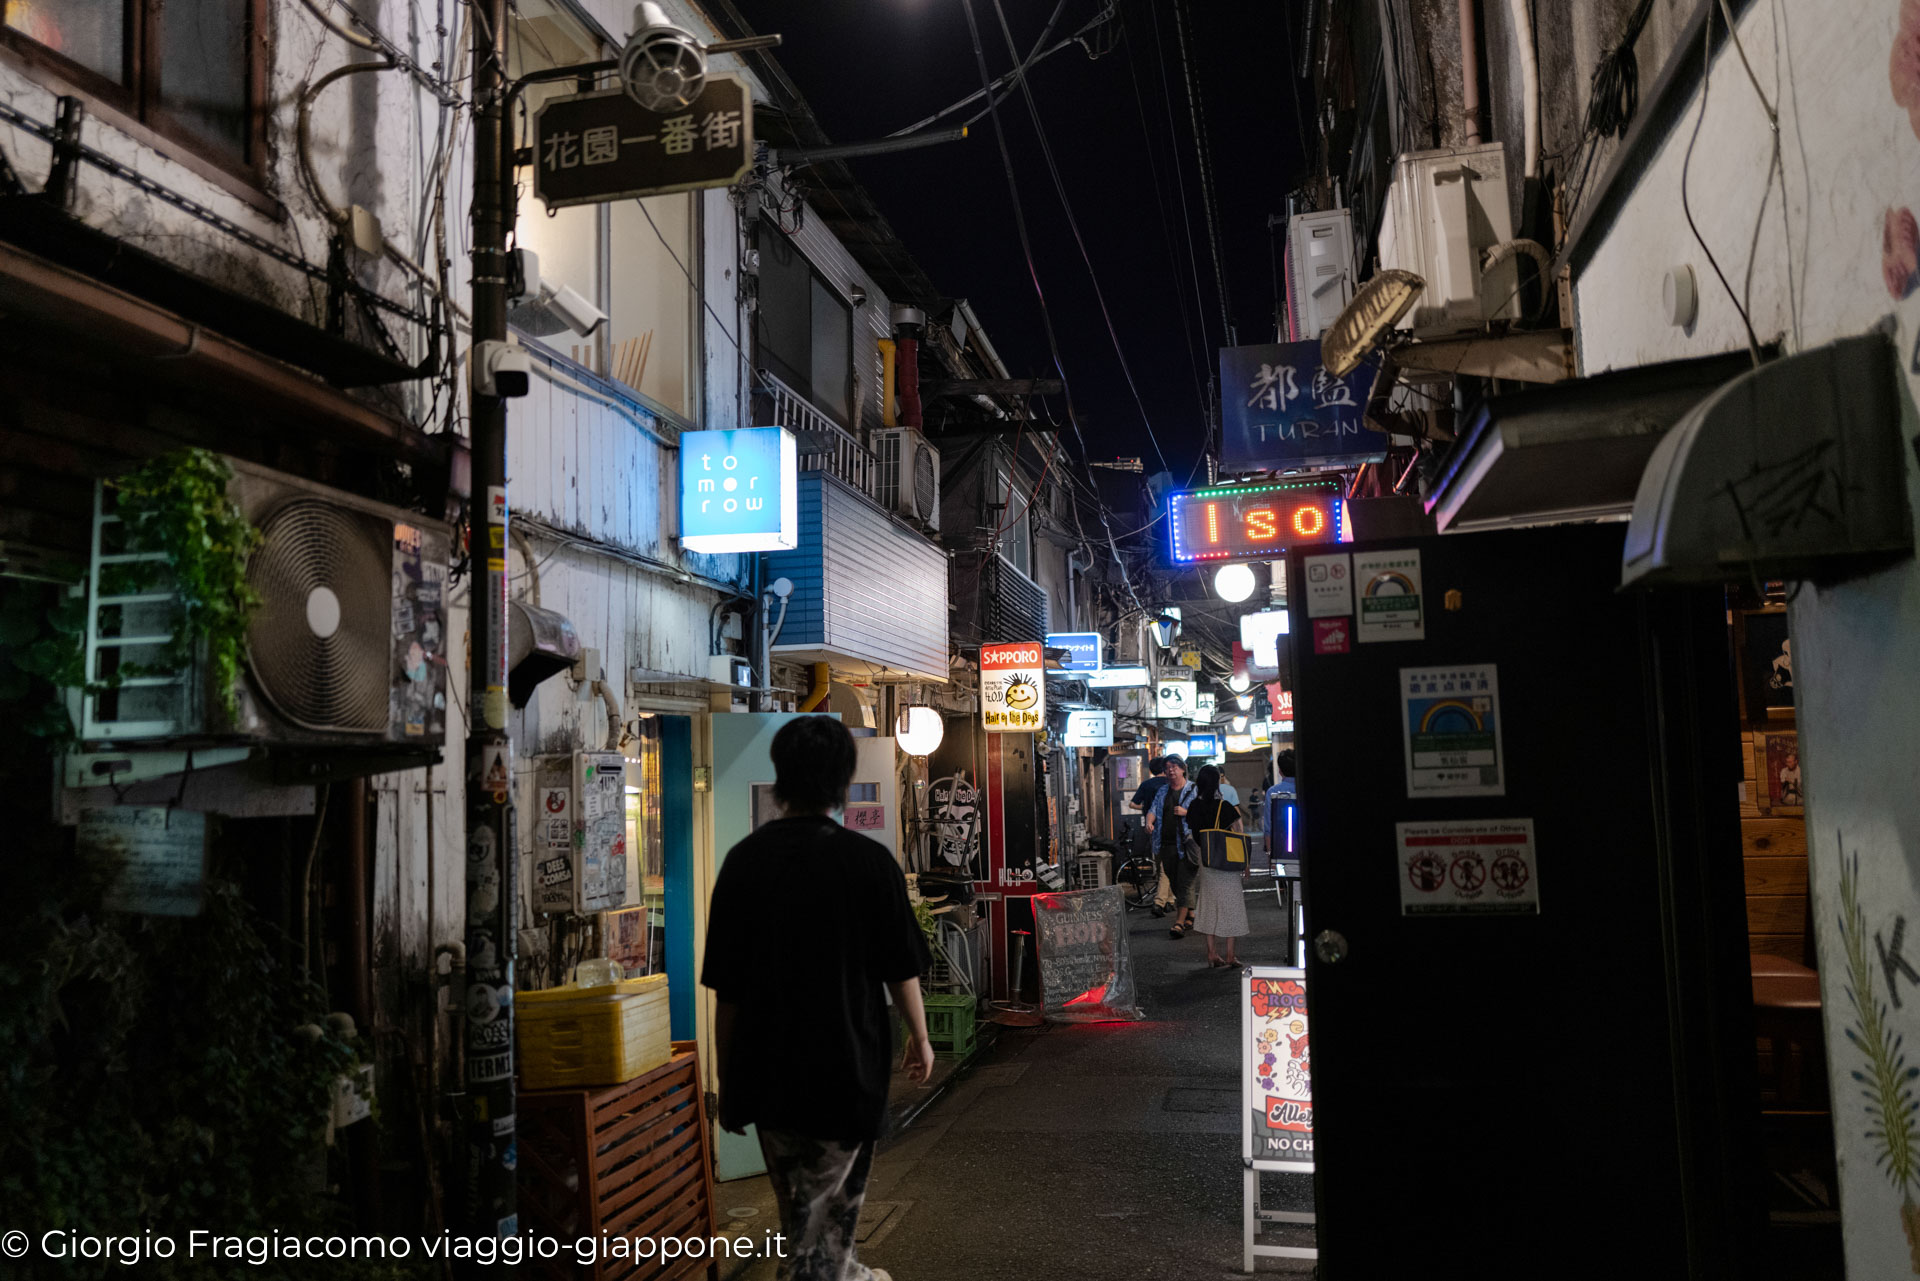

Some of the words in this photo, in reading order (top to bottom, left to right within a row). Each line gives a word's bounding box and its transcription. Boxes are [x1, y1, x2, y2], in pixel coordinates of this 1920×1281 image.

[544, 111, 742, 172] 花園一番街
[1253, 418, 1358, 442] TURAN
[985, 711, 999, 724] Hair
[1022, 711, 1039, 726] Dogs
[1055, 910, 1103, 924] GUINNESS
[1268, 1138, 1290, 1150] NO
